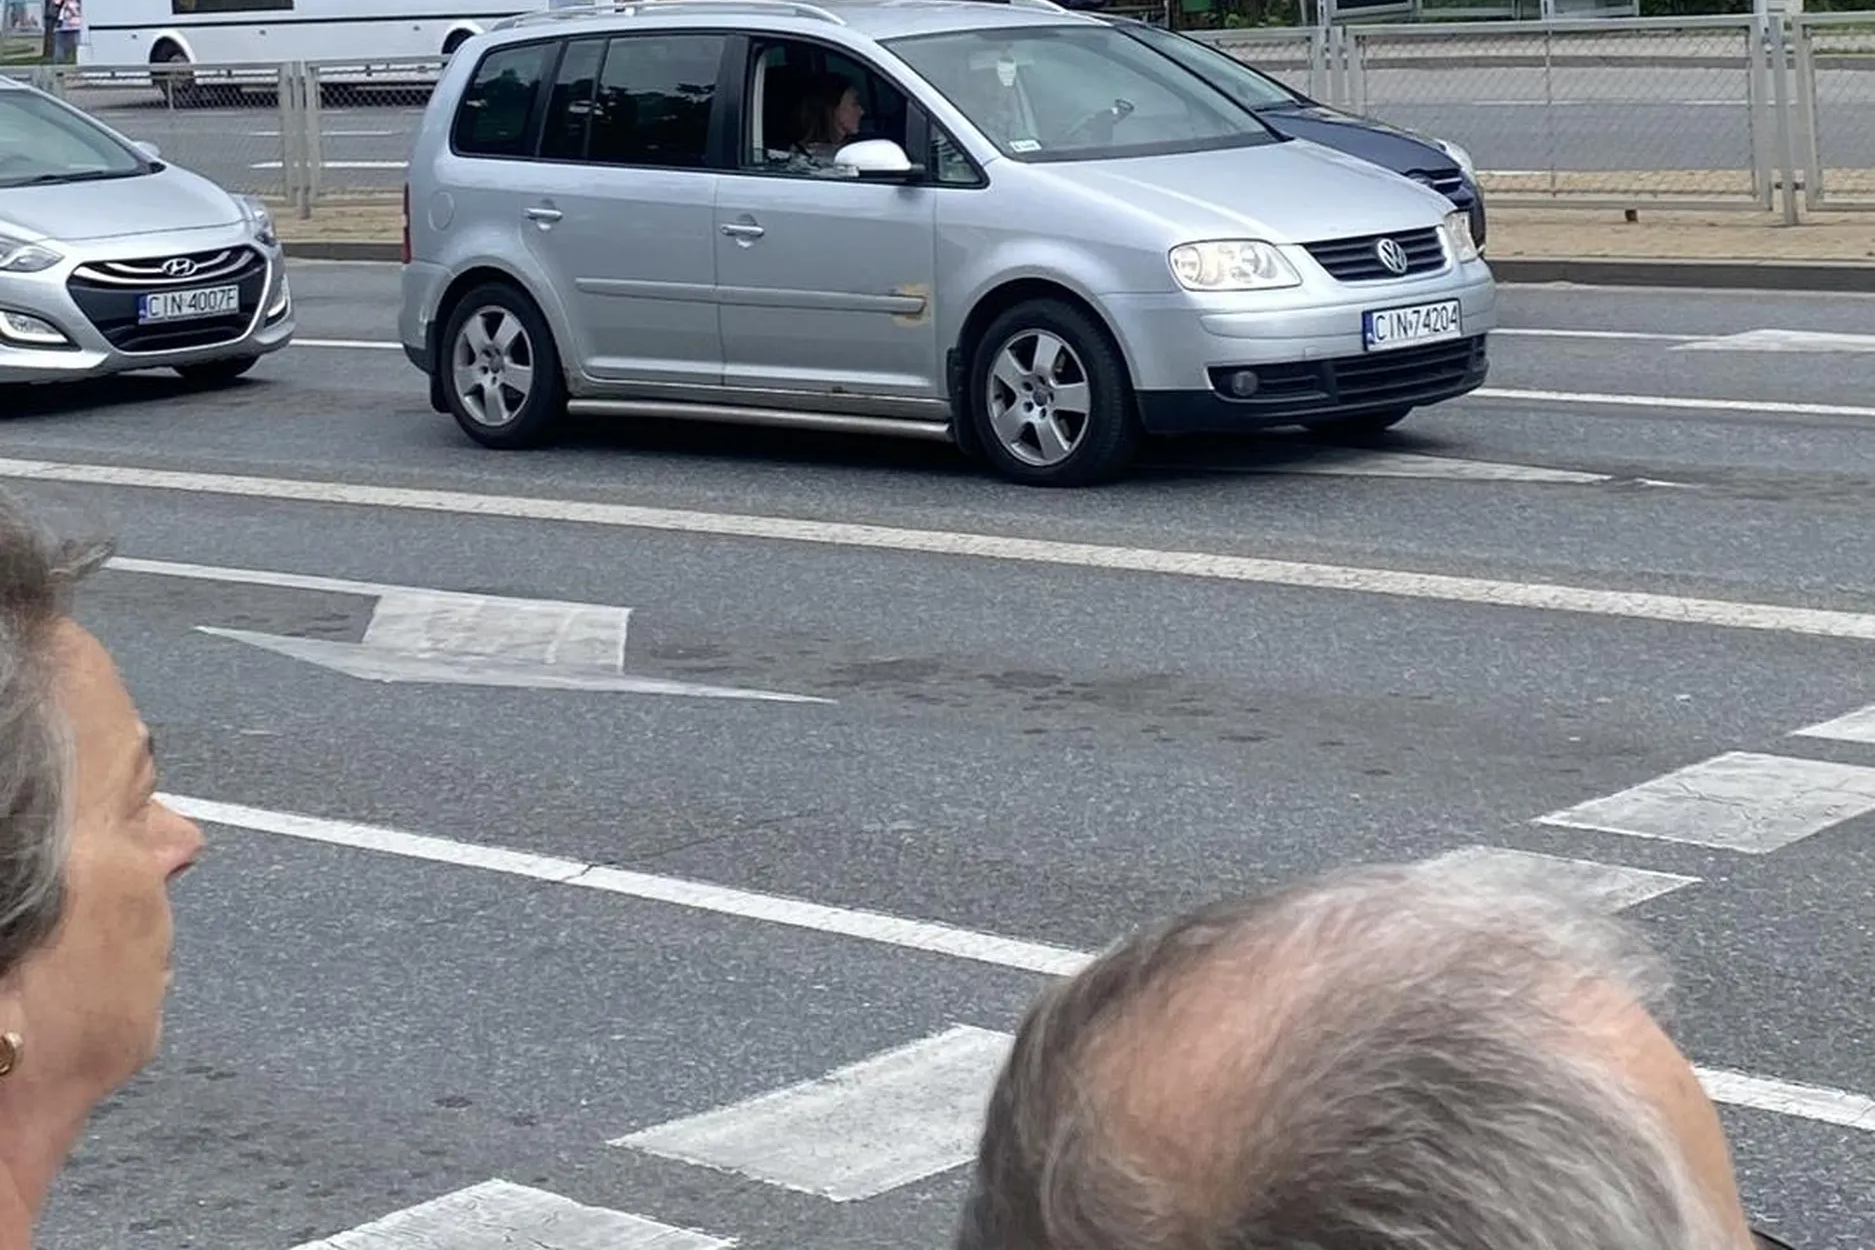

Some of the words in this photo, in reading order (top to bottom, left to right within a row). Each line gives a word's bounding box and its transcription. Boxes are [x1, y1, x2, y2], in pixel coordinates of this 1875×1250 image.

[149, 293, 183, 318] CIN
[187, 287, 236, 312] 4007F
[1374, 311, 1409, 341] CIN
[1411, 304, 1458, 336] 74204
